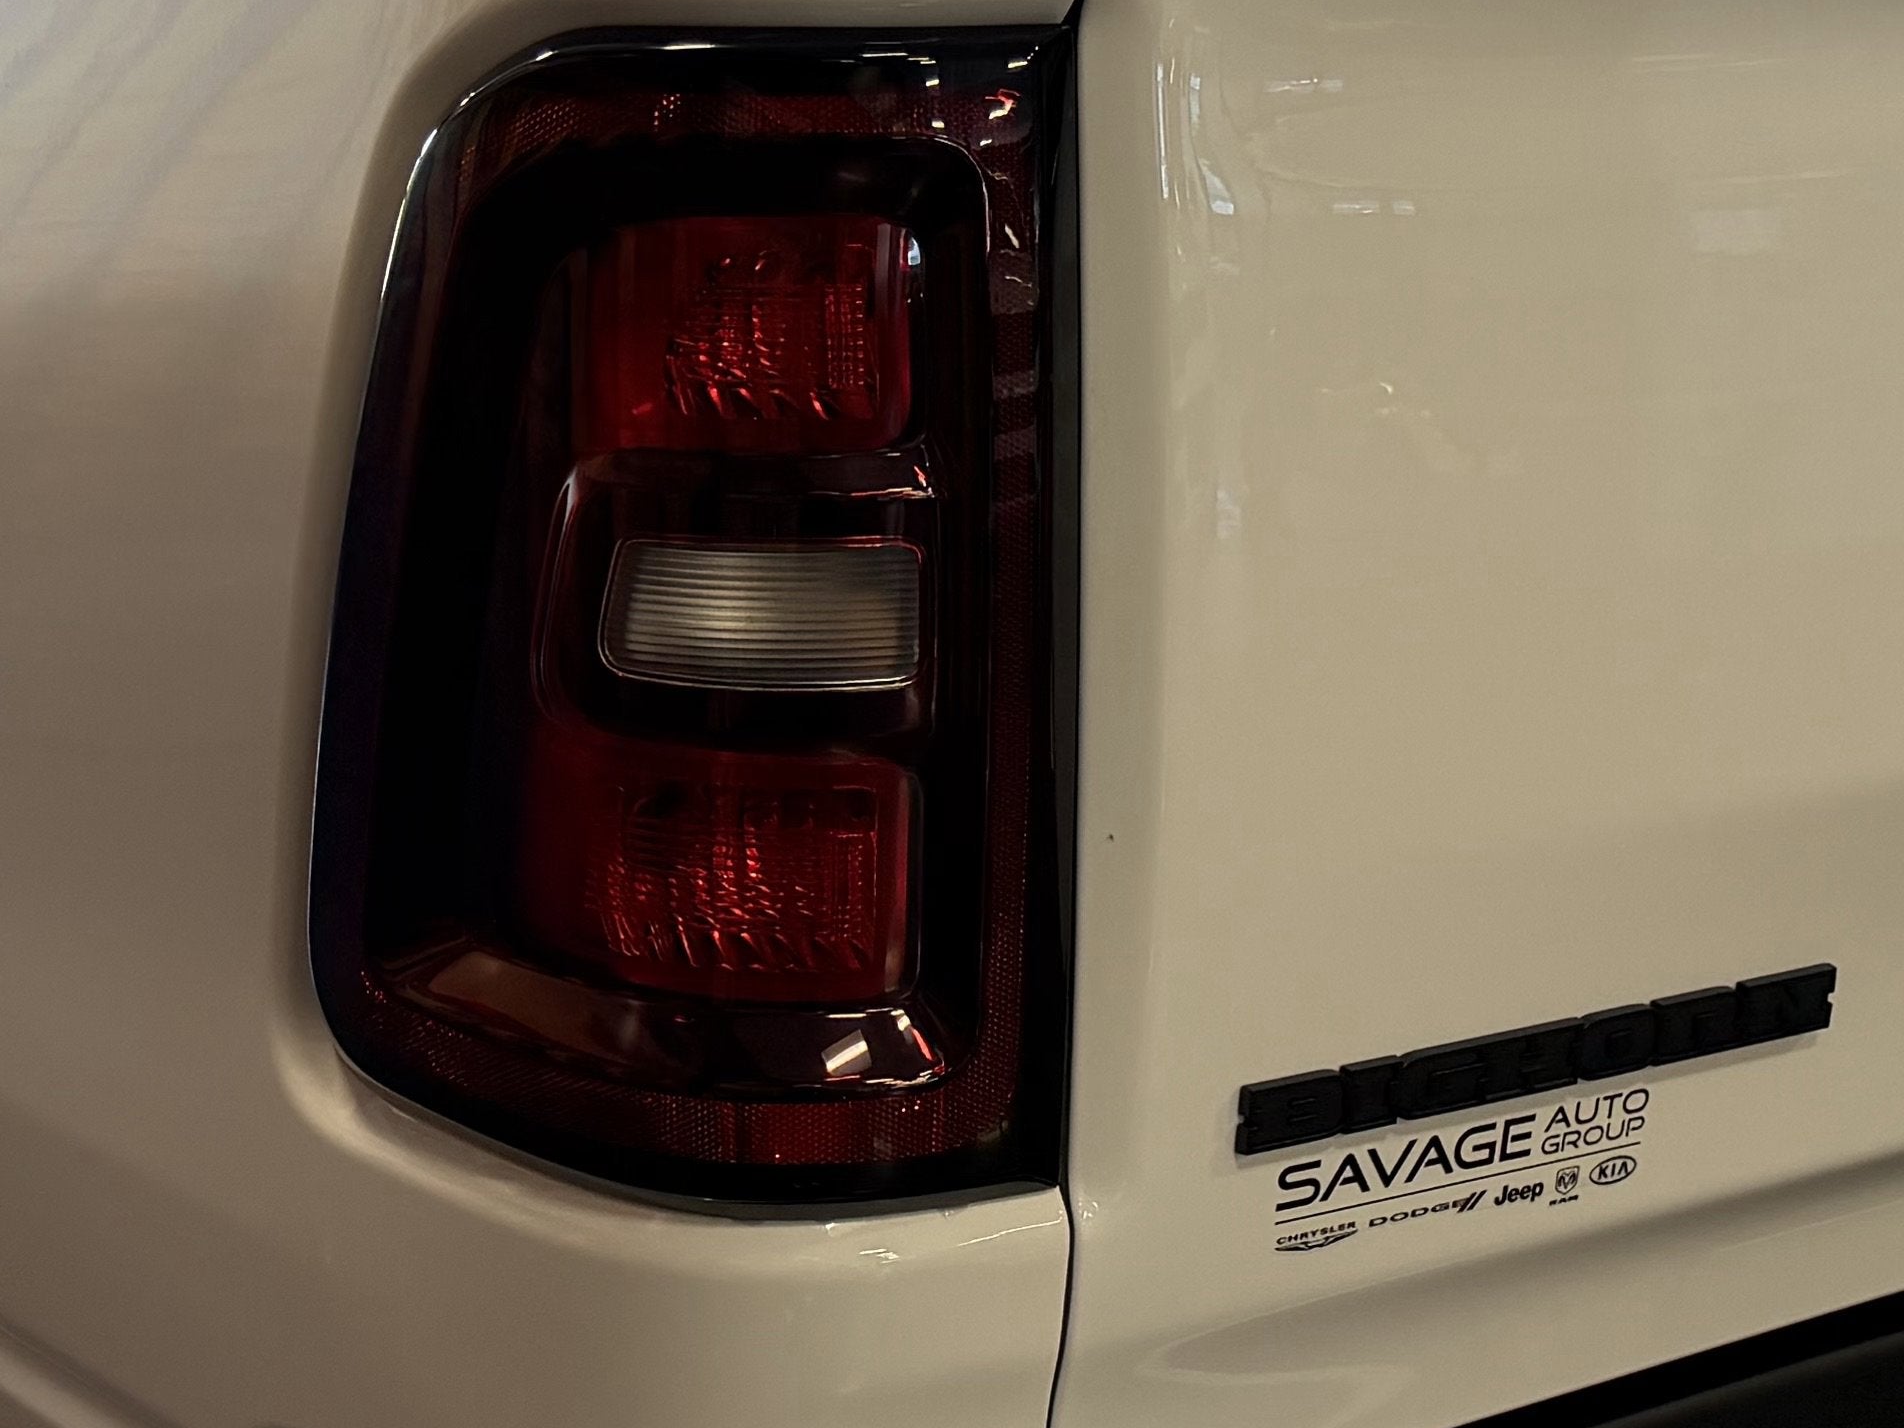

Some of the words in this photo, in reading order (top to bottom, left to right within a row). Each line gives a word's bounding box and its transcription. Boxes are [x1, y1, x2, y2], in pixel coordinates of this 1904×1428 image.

[1275, 1113, 1537, 1212] SAVAGE
[1544, 1088, 1649, 1133] AUTO
[1541, 1115, 1645, 1155] GROUP
[1276, 1221, 1356, 1245] CHRYSLER
[1494, 1182, 1544, 1206] Jeep
